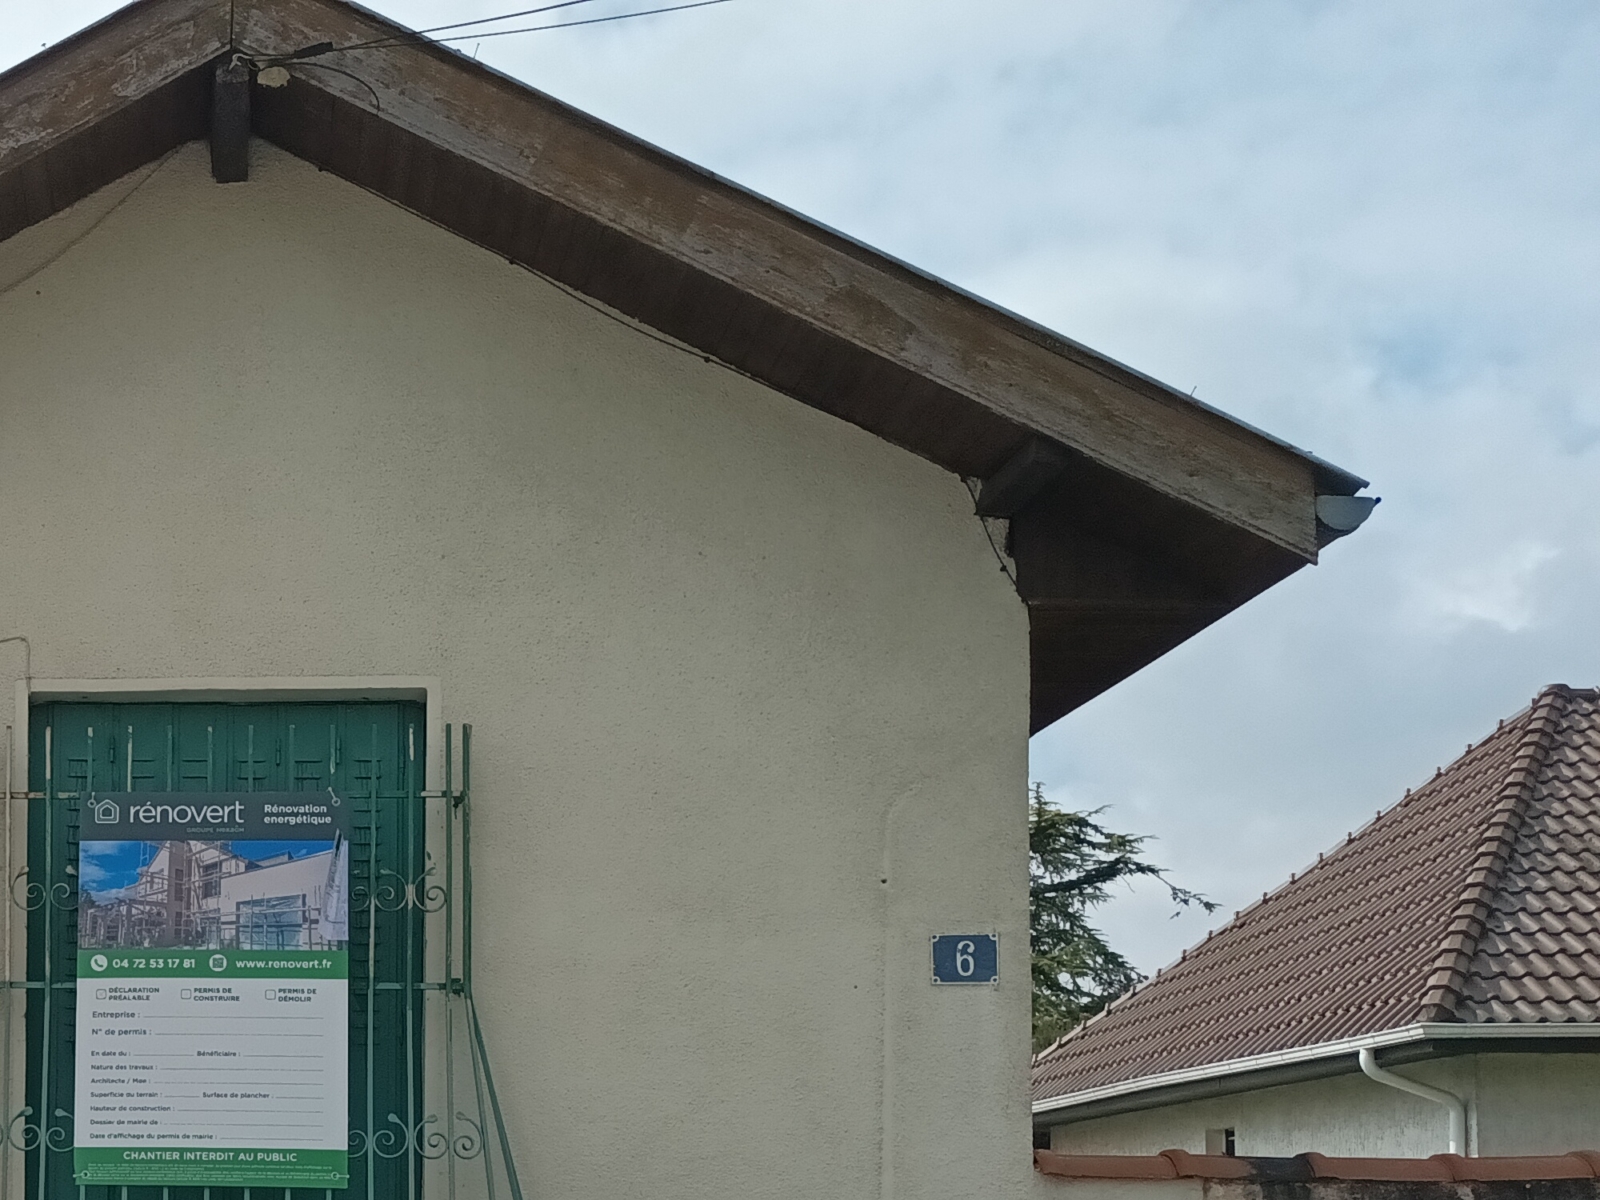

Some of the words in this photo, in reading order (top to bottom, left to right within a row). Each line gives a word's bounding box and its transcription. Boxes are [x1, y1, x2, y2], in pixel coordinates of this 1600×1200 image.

[129, 800, 245, 823] rénovert
[264, 803, 327, 813] Rénovation
[956, 940, 975, 977] 6
[112, 959, 129, 969] 04
[132, 959, 146, 969] 72
[149, 959, 164, 969] 53
[167, 959, 180, 969] 17
[182, 959, 196, 969] 81
[235, 959, 332, 969] www.renovert.fr
[92, 1011, 136, 1019] Entreprise
[118, 1028, 147, 1036] permis
[123, 1151, 180, 1160] CHANTIER
[183, 1151, 235, 1161] INTERDIT
[237, 1152, 254, 1161] AU
[257, 1152, 298, 1162] PUBLIC
